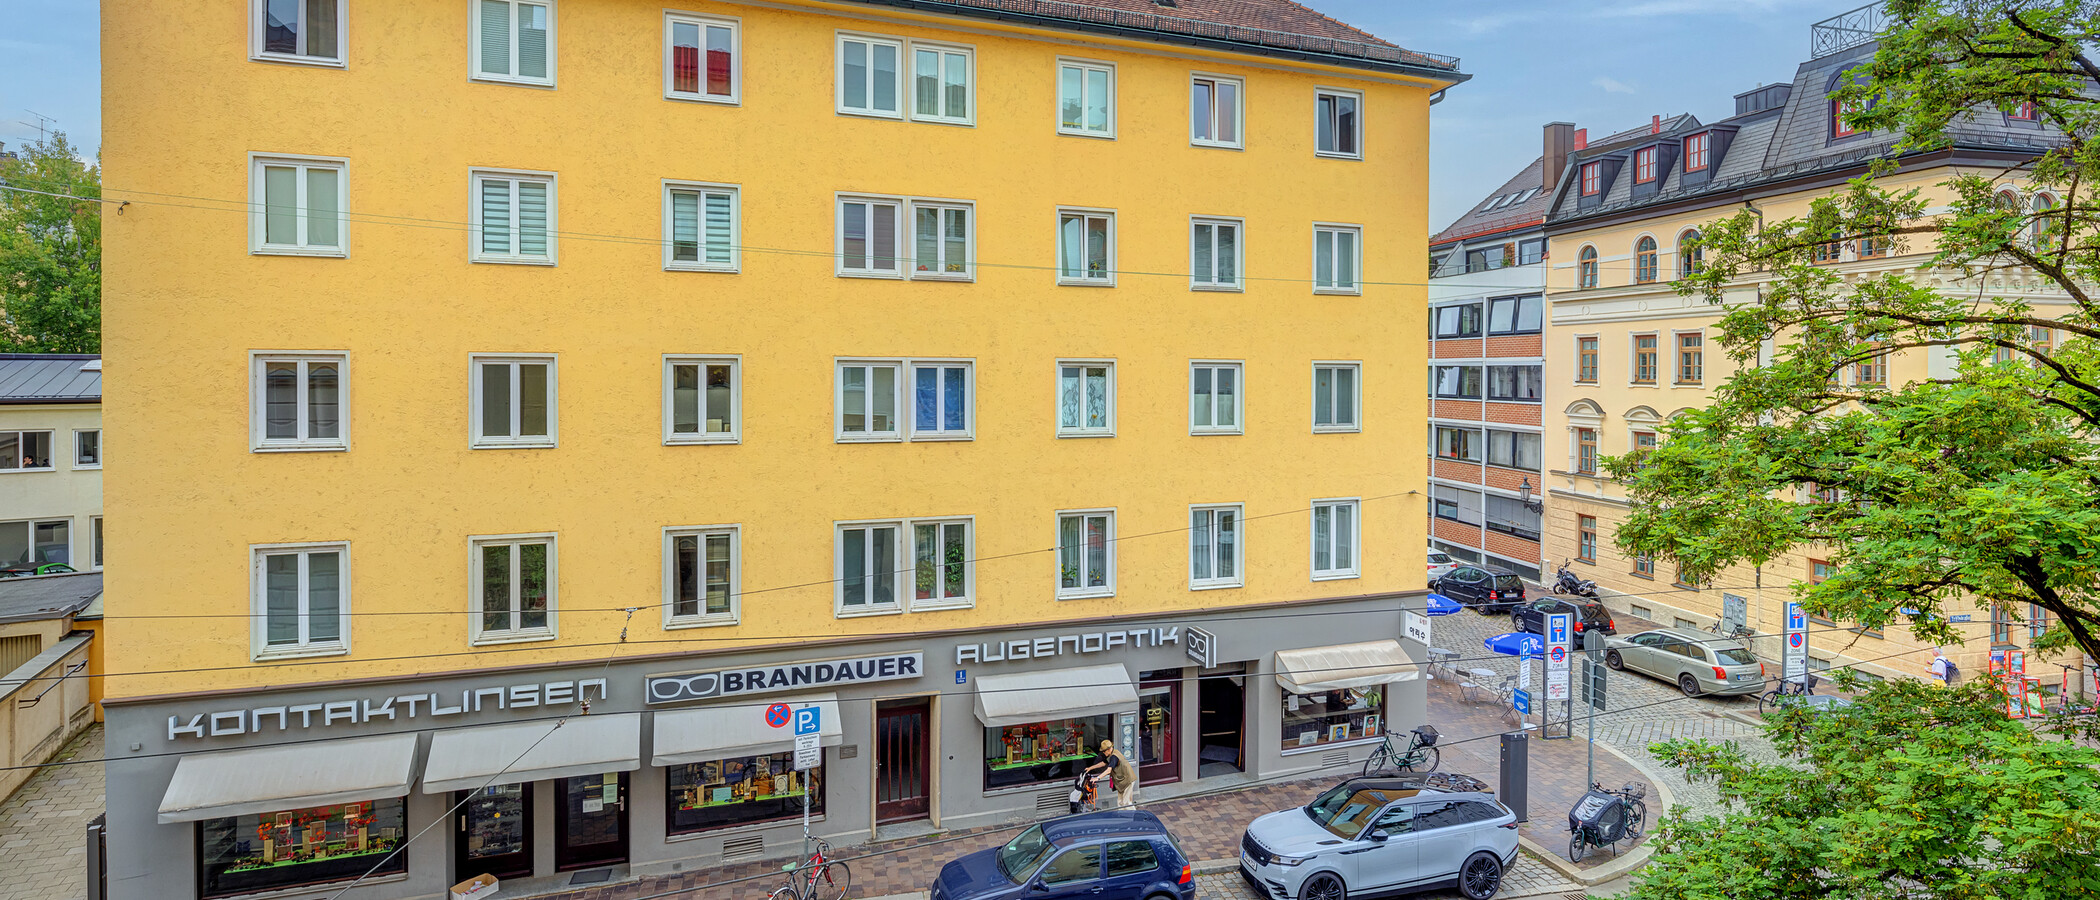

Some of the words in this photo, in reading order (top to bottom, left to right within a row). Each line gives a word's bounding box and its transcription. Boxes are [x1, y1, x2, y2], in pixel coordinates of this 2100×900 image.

[956, 627, 1179, 665] AUGENOPTIK
[1523, 641, 1529, 659] P
[723, 656, 917, 693] BRANDAUER
[168, 678, 607, 740] KONTAKTLINSEN
[798, 711, 813, 732] P
